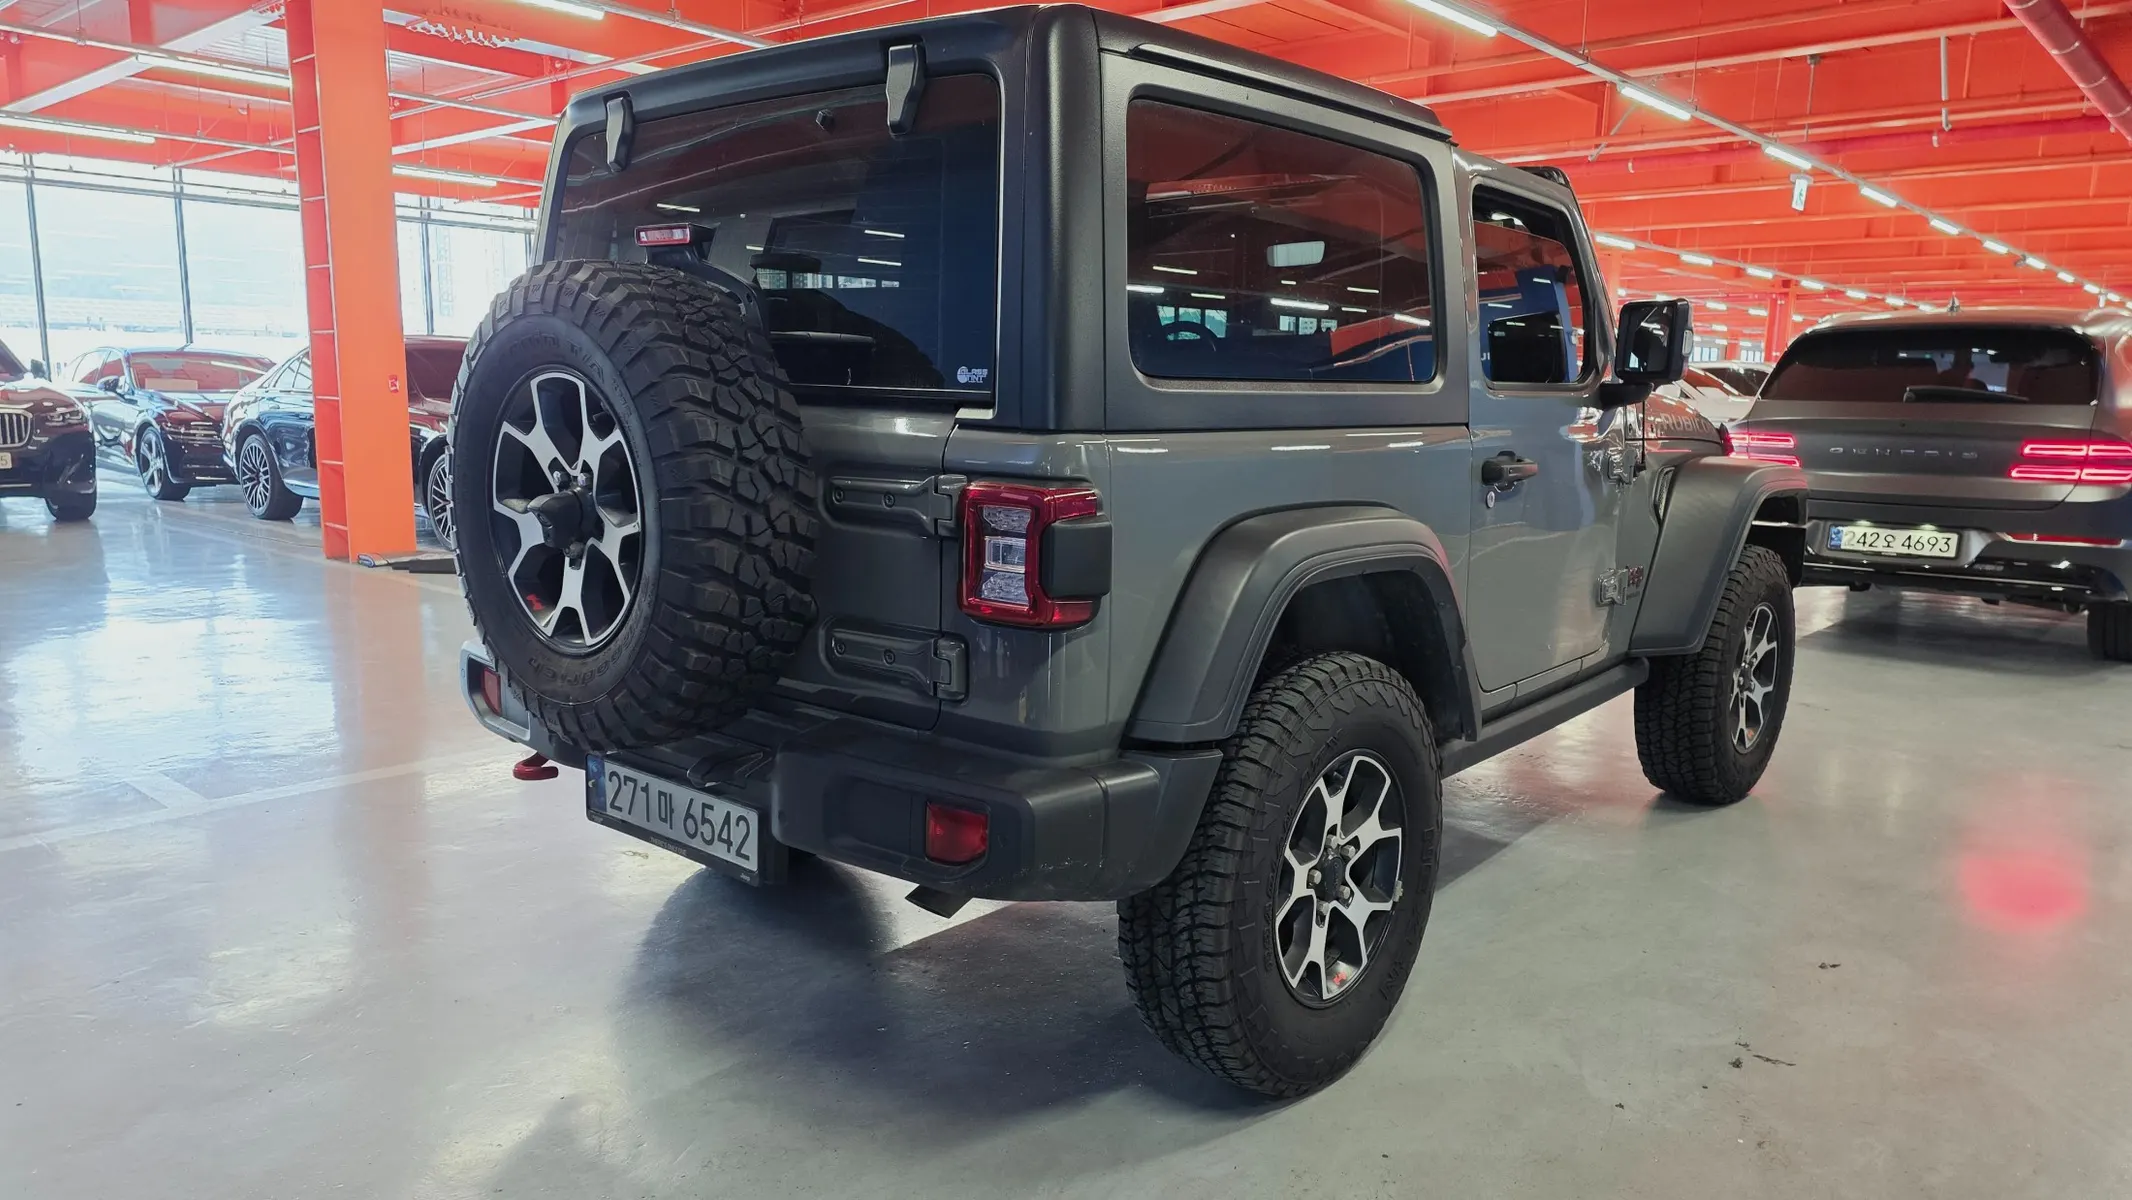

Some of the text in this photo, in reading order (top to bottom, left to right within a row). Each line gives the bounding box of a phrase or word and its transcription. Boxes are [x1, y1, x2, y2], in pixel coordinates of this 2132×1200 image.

[1660, 412, 1712, 434] RUBICO
[1901, 534, 1952, 553] 4693
[608, 770, 751, 862] 271마 6542
